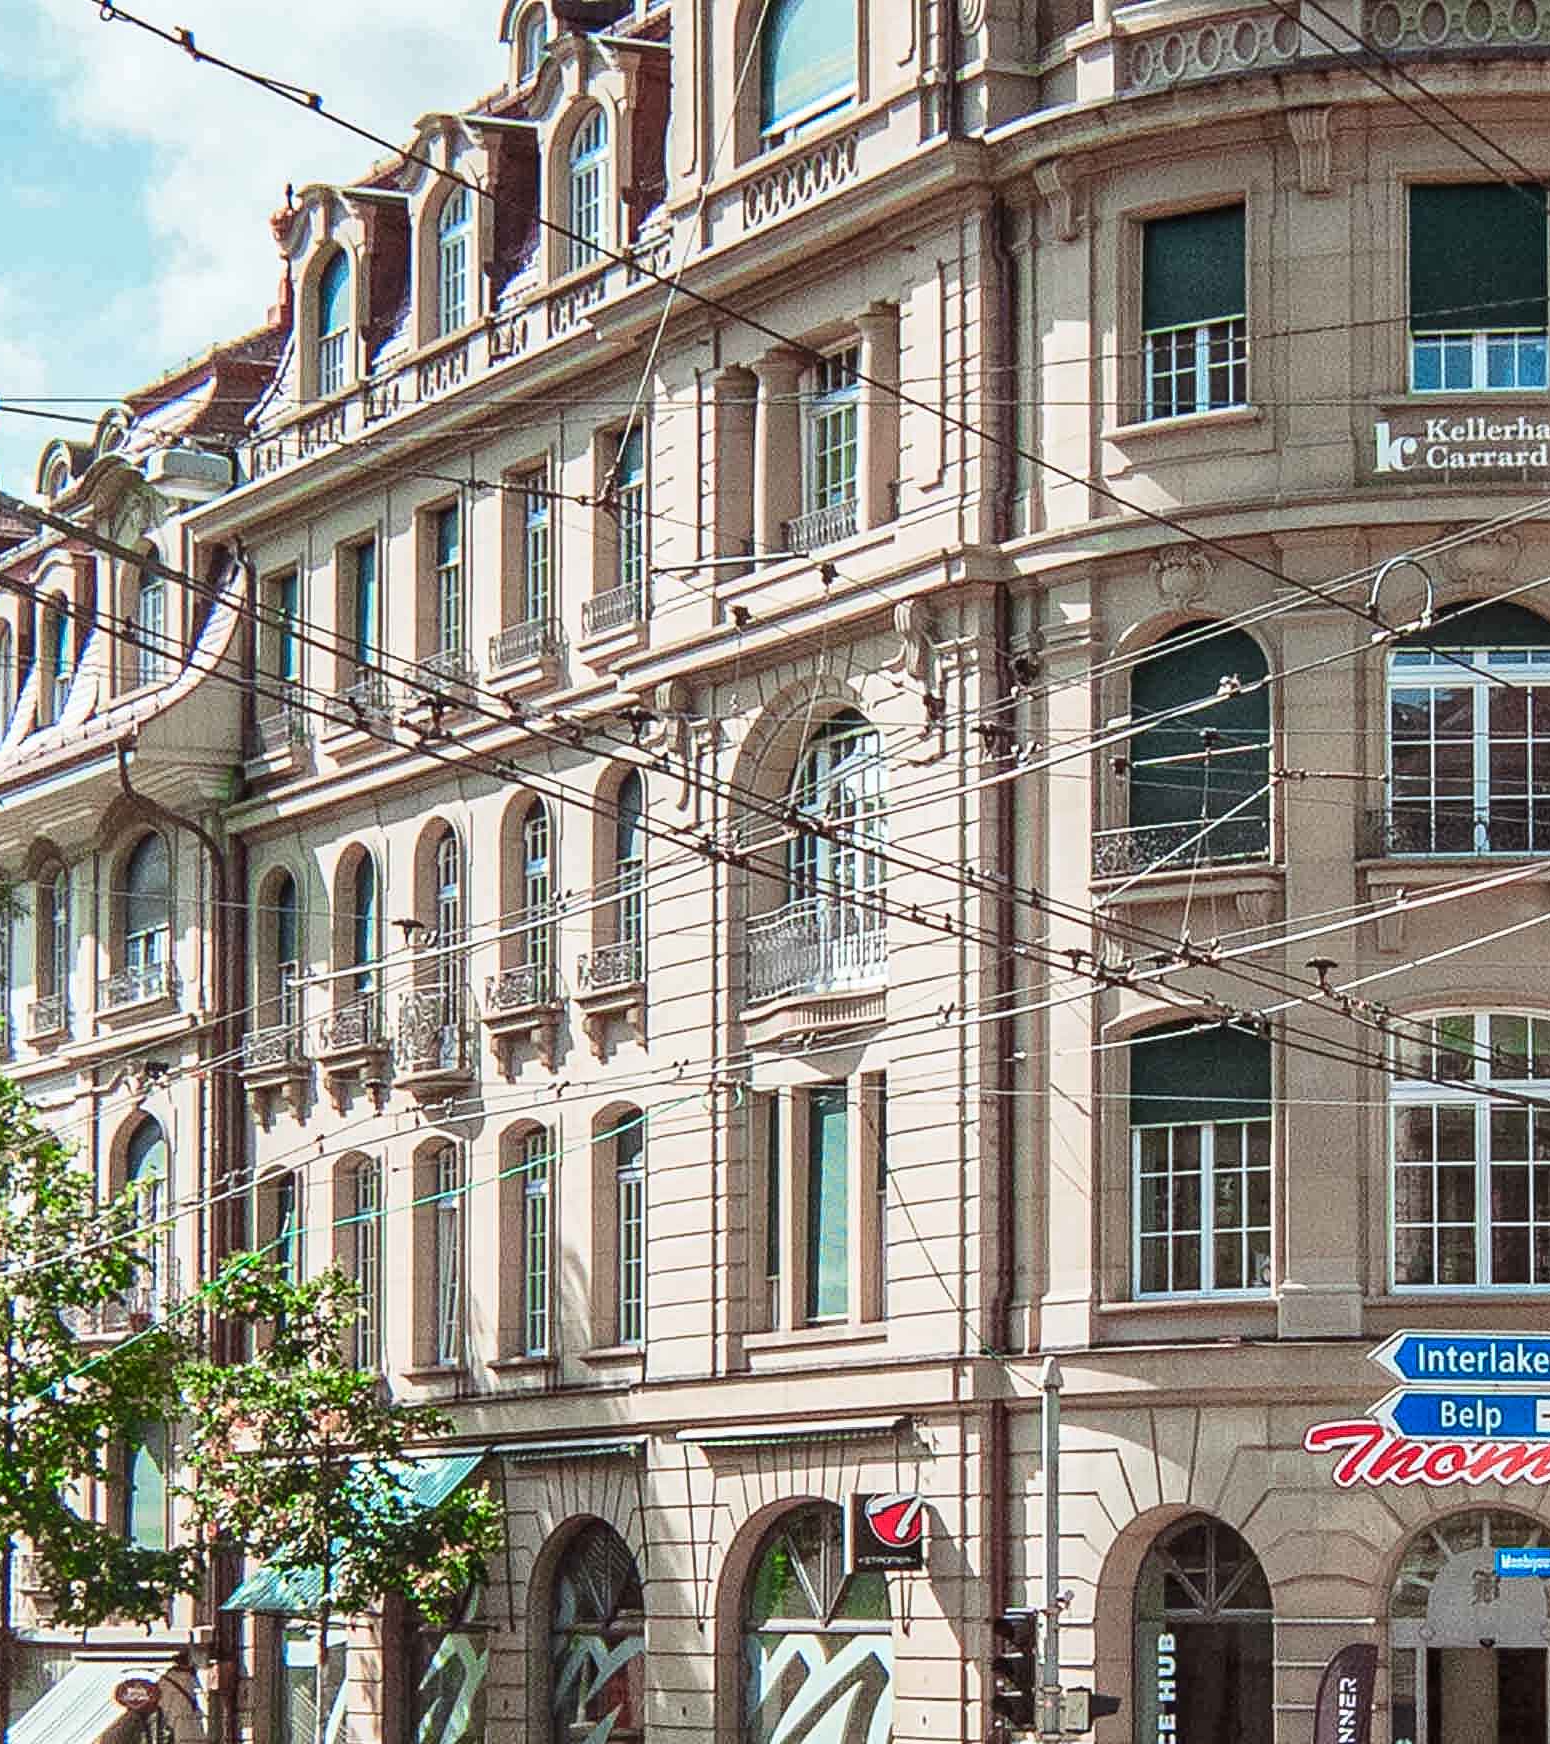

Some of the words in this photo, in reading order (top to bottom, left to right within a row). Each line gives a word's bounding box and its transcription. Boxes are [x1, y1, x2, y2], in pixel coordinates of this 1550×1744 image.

[1426, 444, 1548, 469] Carrard
[1440, 1400, 1502, 1435] Belp
[1157, 1632, 1177, 1703] HUB
